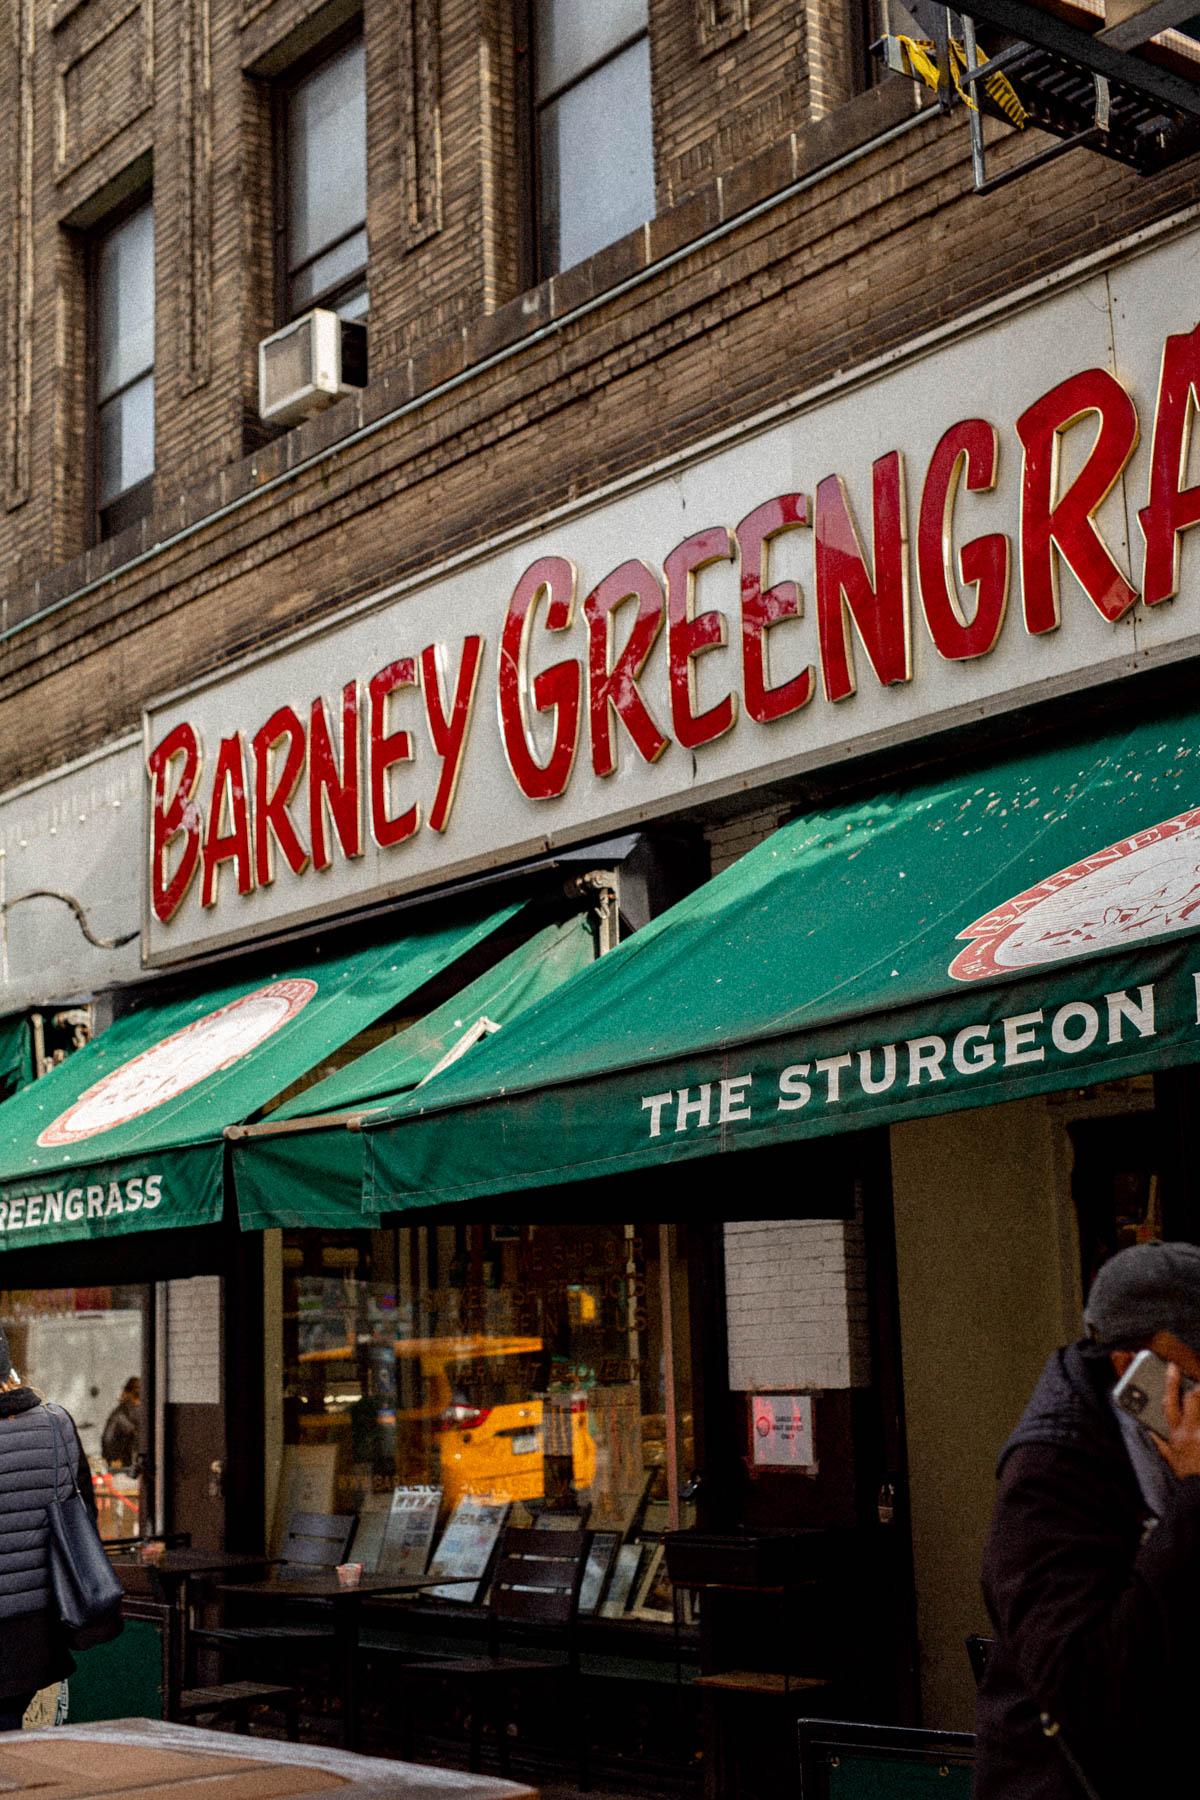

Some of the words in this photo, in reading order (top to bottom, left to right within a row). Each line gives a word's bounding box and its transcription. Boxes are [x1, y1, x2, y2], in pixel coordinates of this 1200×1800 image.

[148, 635, 484, 924] BARNEY
[641, 1072, 753, 1138] THE
[777, 983, 1158, 1112] STURGEON
[552, 1240, 595, 1265] SHIP
[603, 1236, 645, 1264] OUR
